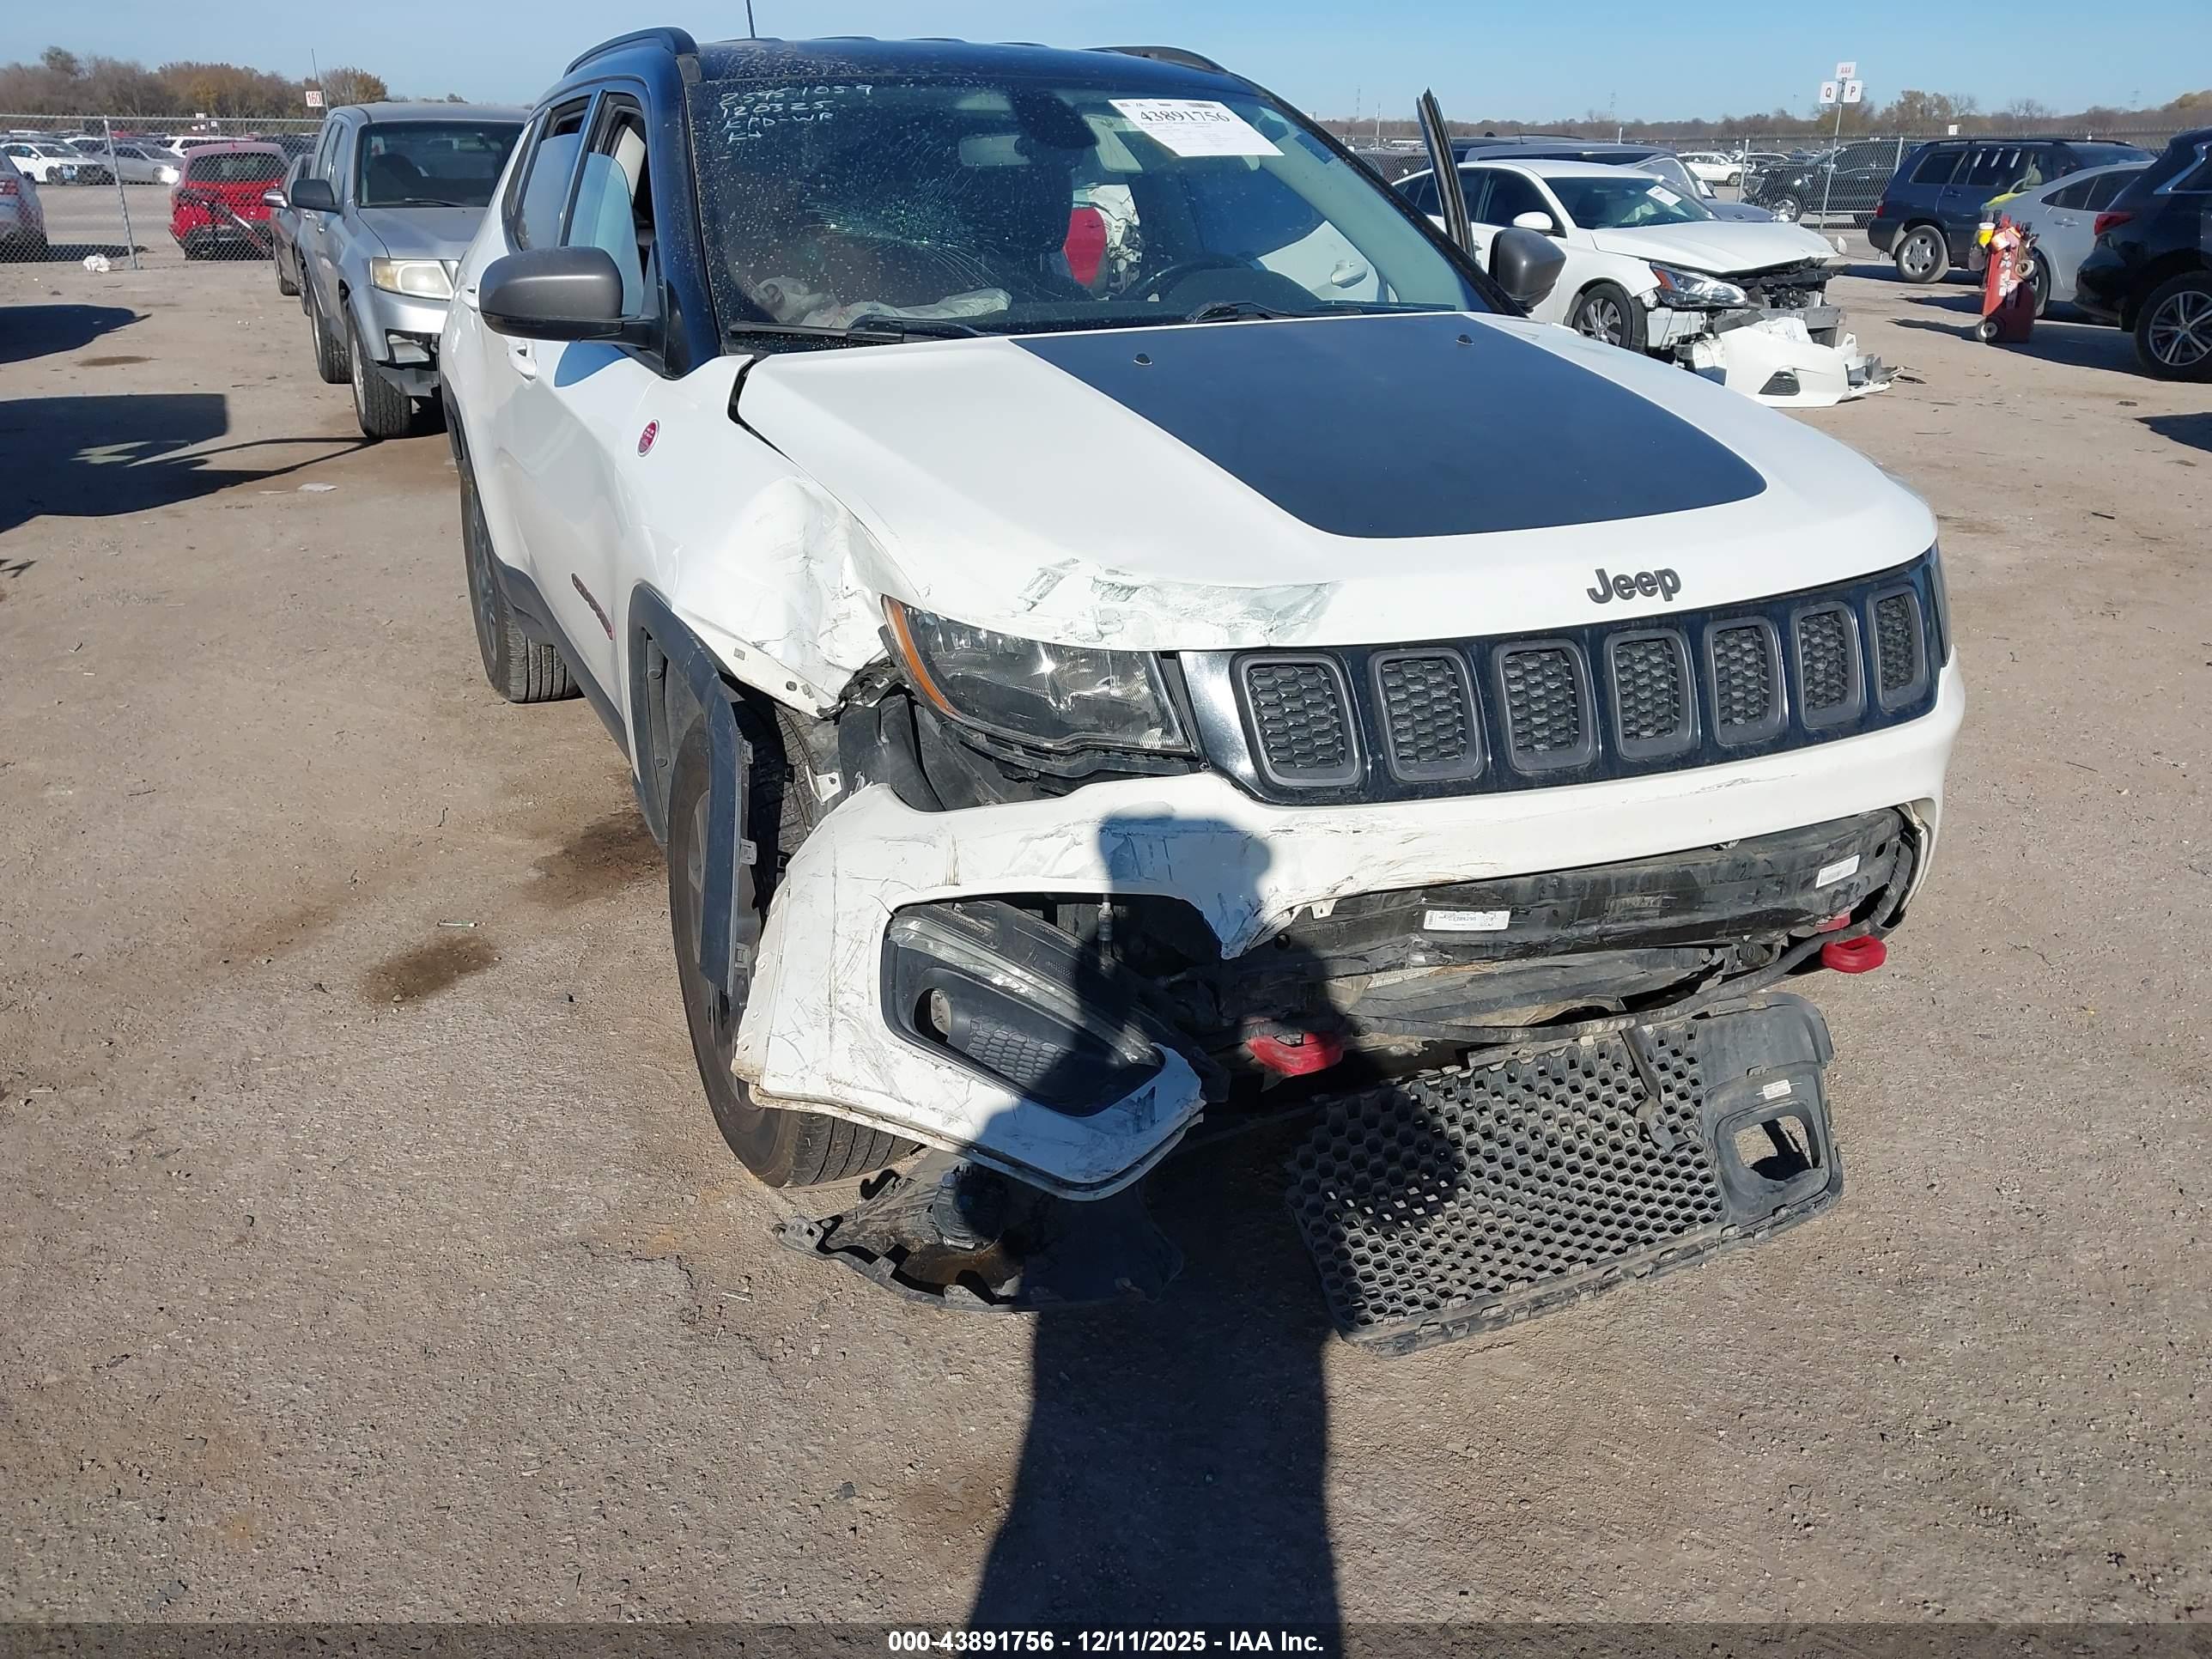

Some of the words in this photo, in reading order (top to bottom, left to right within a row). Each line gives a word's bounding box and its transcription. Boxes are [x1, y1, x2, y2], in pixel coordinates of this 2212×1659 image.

[1826, 88, 1832, 98] Q
[1850, 86, 1856, 96] P
[721, 100, 835, 118] 120325
[1140, 110, 1231, 122] 43891756
[1587, 568, 1681, 604] Jeep
